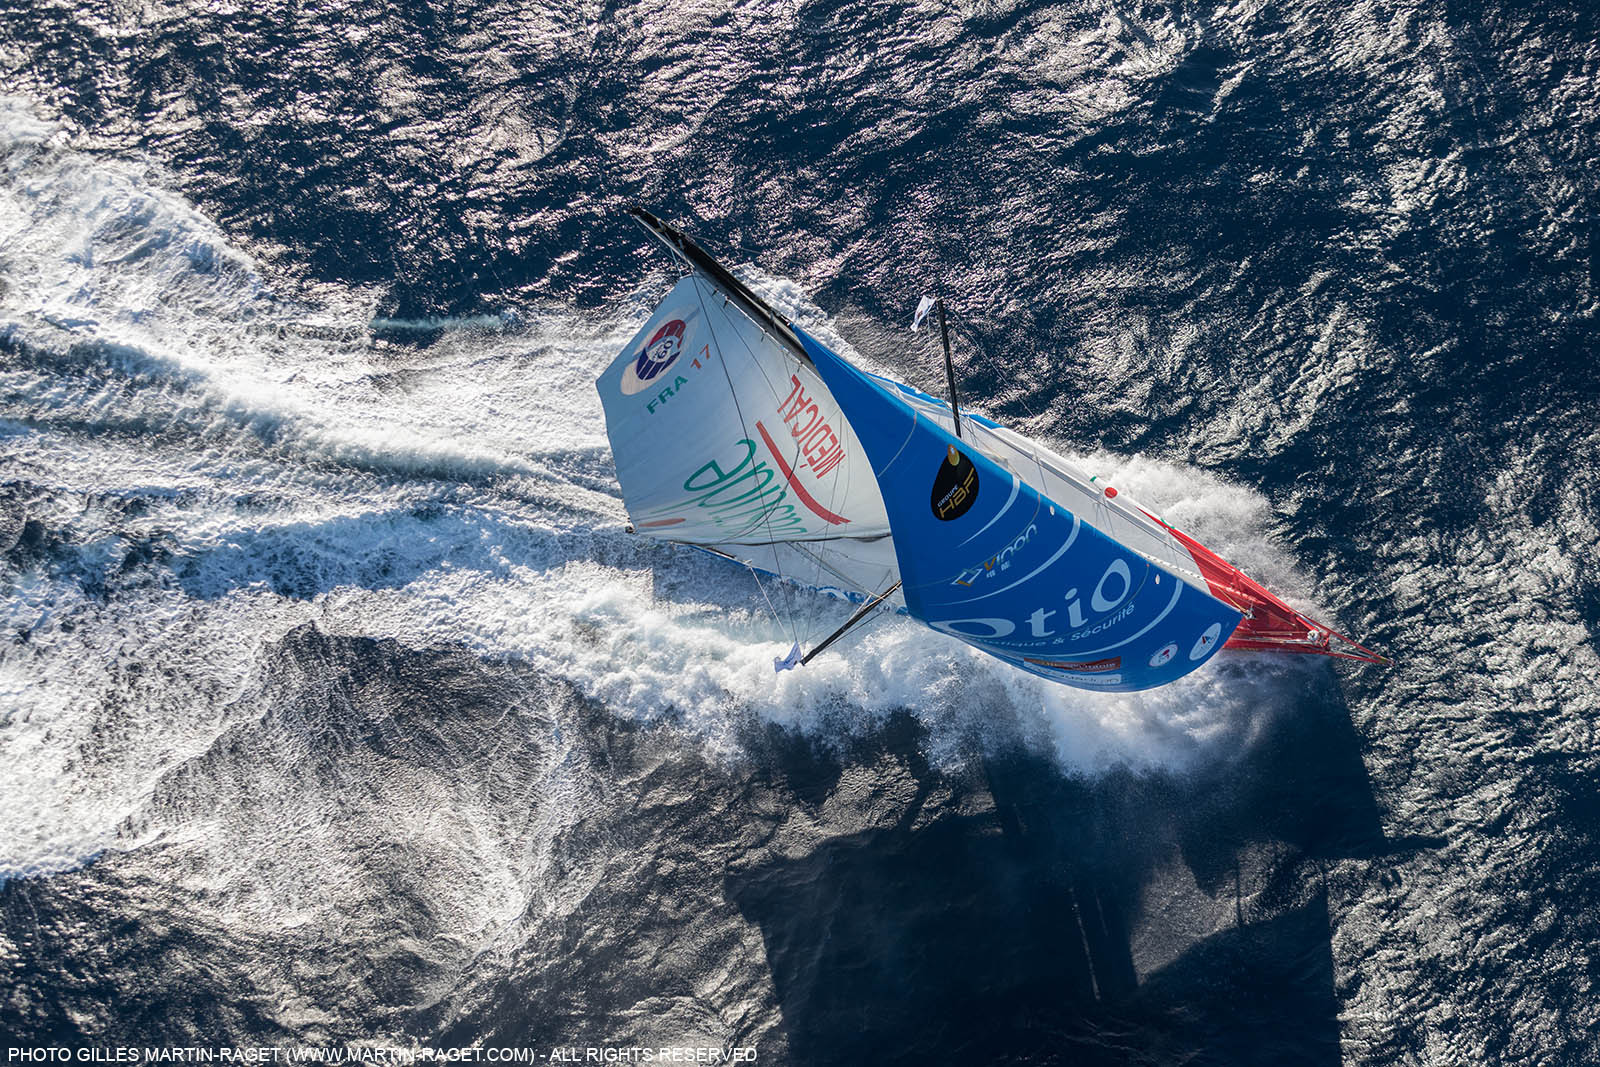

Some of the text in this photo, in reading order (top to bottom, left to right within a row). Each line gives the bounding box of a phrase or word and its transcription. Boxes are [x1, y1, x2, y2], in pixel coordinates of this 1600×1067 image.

[646, 375, 688, 415] FRA
[690, 344, 711, 370] 17
[777, 374, 846, 479] MÉDICAL
[1071, 603, 1136, 642] Sécurité
